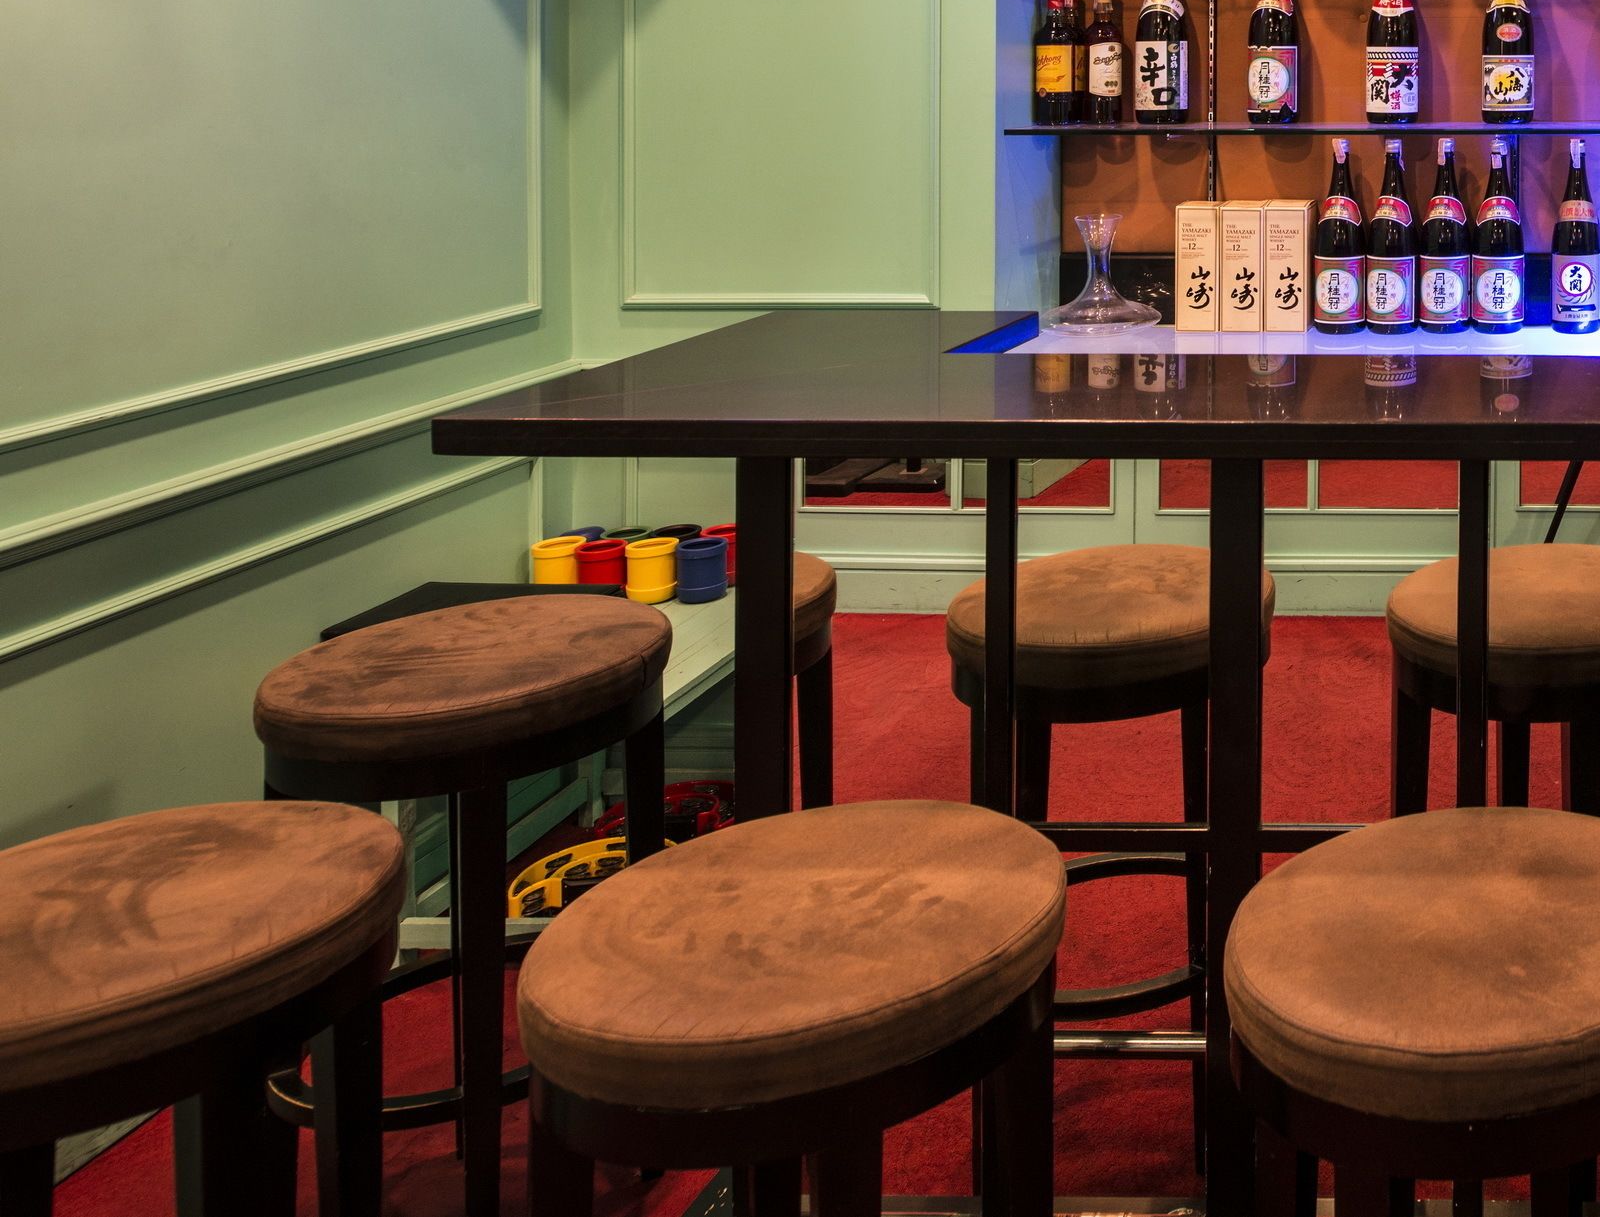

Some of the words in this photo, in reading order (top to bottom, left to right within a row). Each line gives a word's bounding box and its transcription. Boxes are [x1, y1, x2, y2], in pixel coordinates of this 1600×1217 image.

[1259, 62, 1270, 98] 月桂冠
[1188, 243, 1197, 251] 12
[1232, 244, 1241, 252] 12
[1276, 244, 1285, 252] 12
[1328, 273, 1341, 310] 月桂冠
[1376, 273, 1388, 310] 月桂冠
[1433, 272, 1446, 310] 月桂冠
[1492, 272, 1505, 310] 月桂冠
[1569, 266, 1582, 292] 大関
